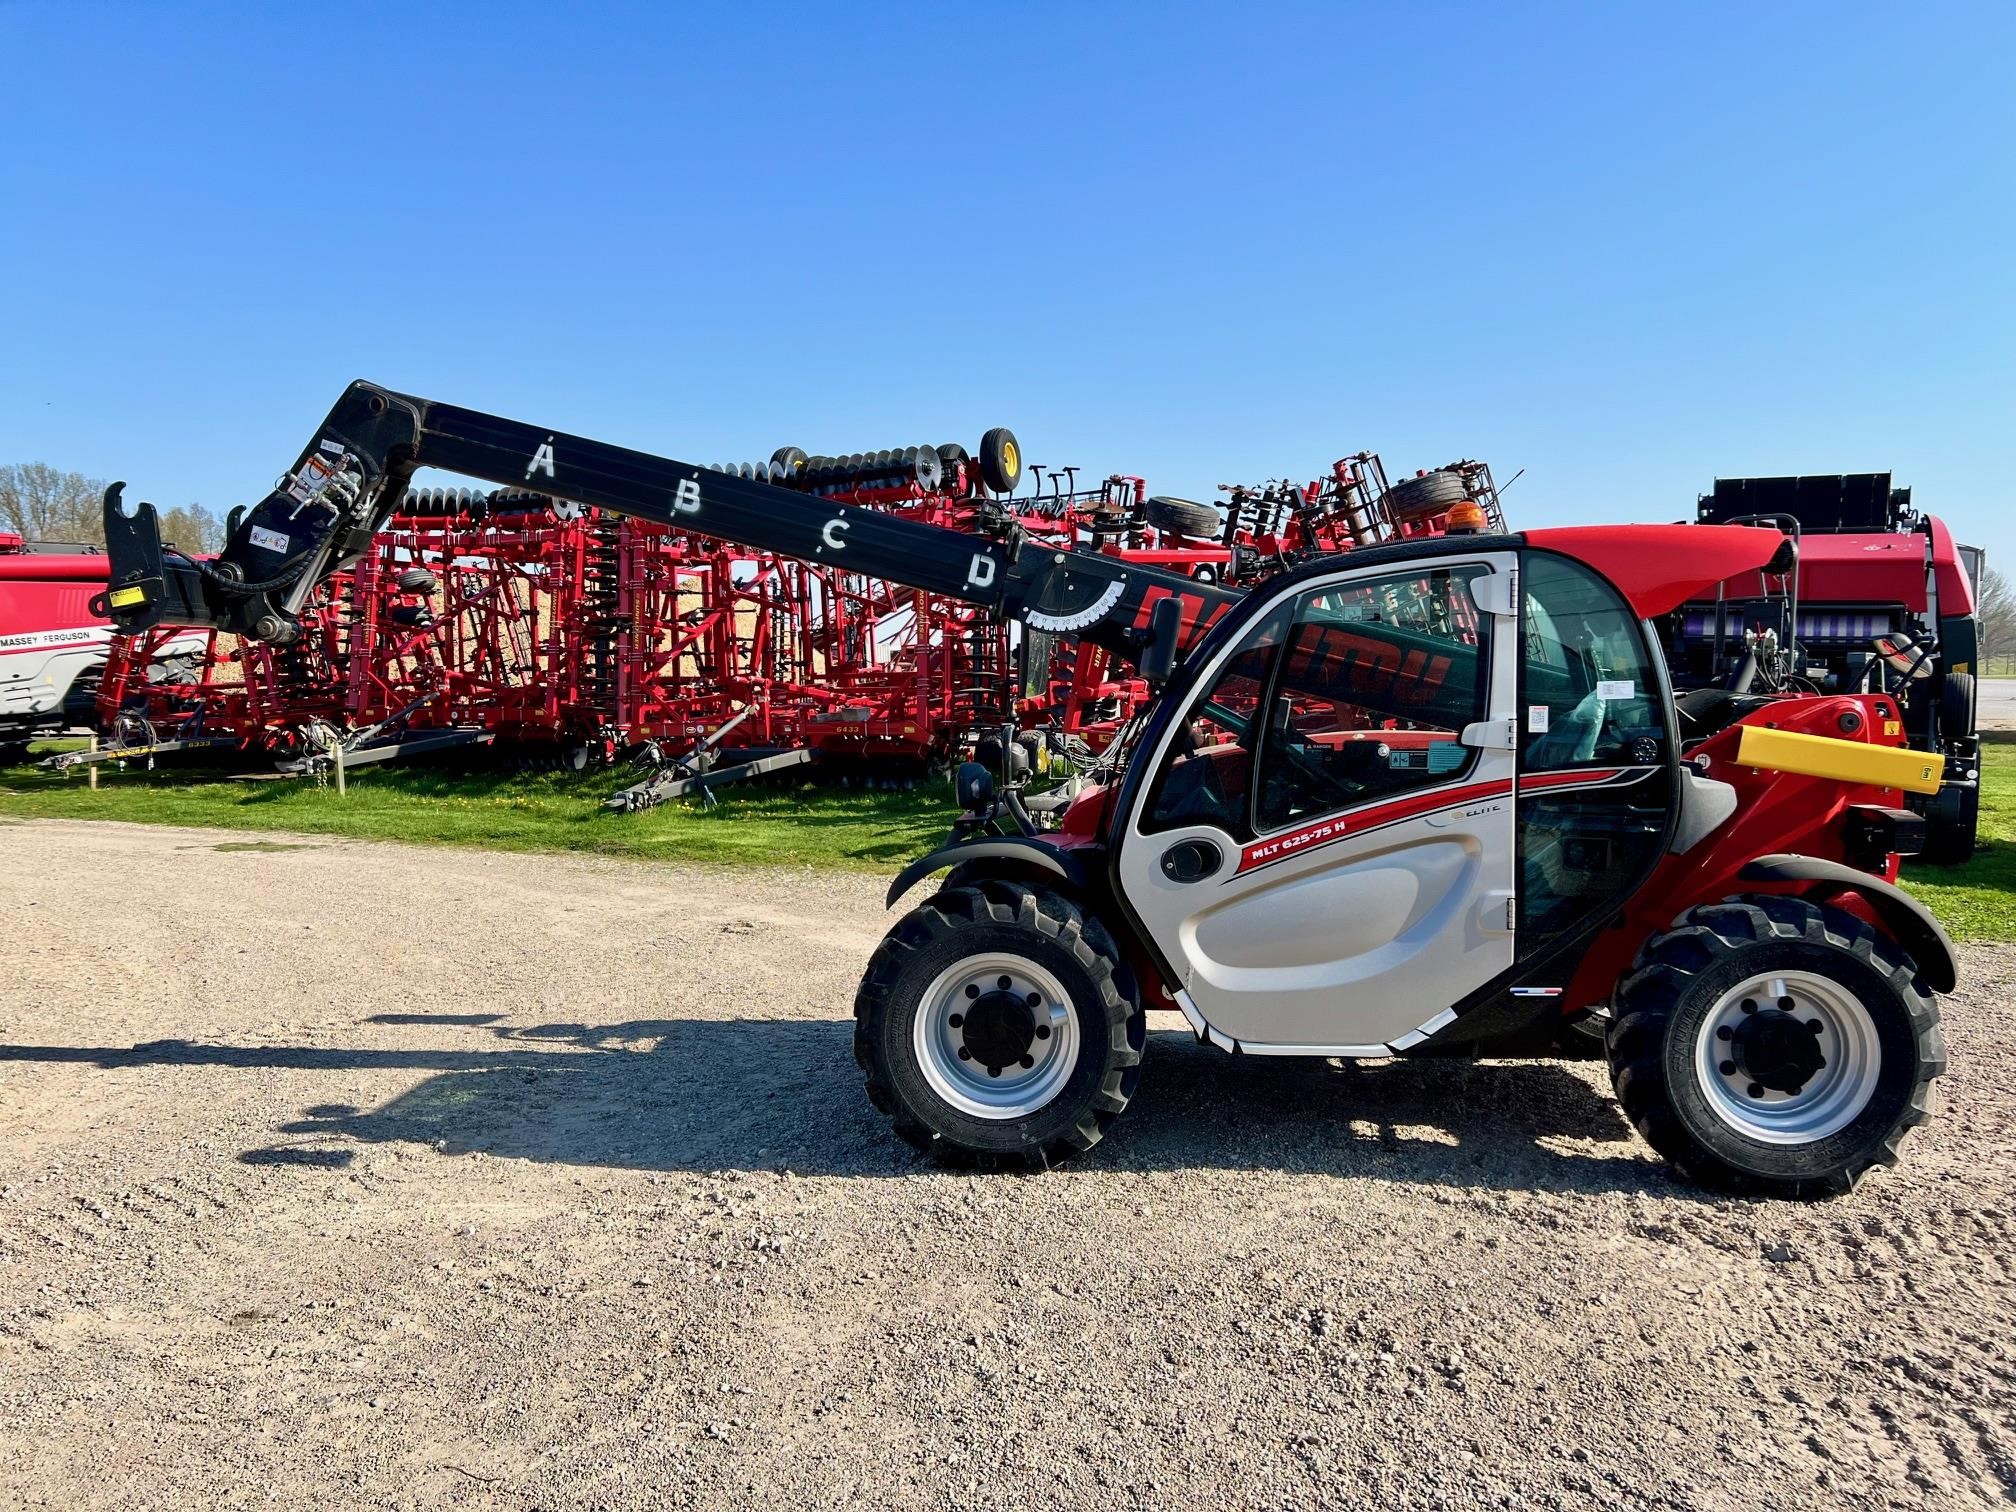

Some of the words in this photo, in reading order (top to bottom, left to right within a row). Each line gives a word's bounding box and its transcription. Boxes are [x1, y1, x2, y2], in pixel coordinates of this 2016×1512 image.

[528, 443, 555, 478] A
[675, 478, 702, 513] B
[822, 518, 850, 549] C
[967, 553, 996, 587] D
[0, 636, 38, 647] MASSEY
[43, 631, 91, 643] FERGUSON
[1466, 805, 1501, 817] ELITE
[1251, 843, 1280, 860] MLT
[1282, 826, 1332, 849] 625-75
[1334, 821, 1346, 832] H
